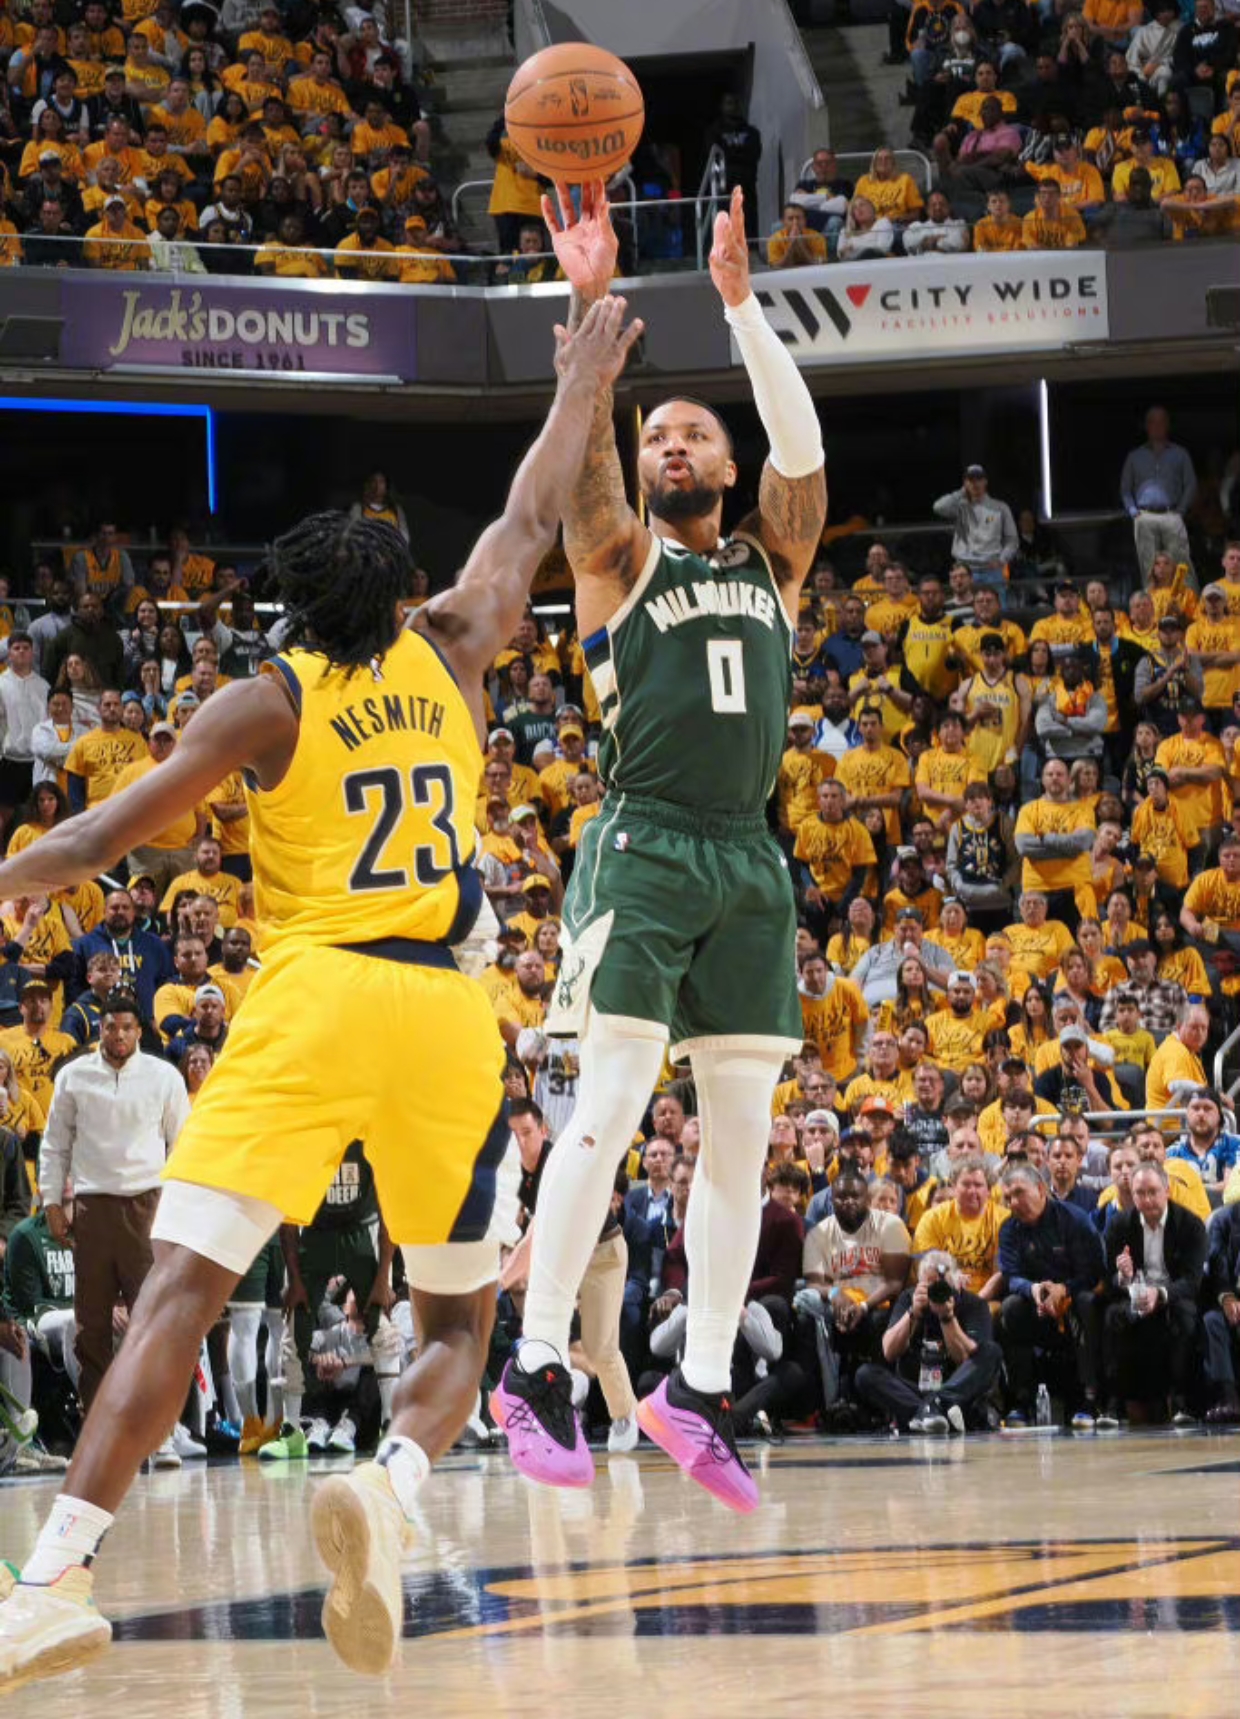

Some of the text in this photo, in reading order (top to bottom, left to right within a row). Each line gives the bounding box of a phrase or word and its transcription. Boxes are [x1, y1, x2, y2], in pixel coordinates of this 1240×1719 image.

[537, 129, 625, 160] Wilson
[880, 276, 1097, 311] CITY WIDE
[109, 289, 370, 356] Jack's DONUTS
[881, 306, 1101, 331] FACILITY SOLUTIONS
[181, 350, 306, 371] SINCE 1961
[644, 580, 776, 634] MILWUKEE
[707, 639, 747, 714] 0
[329, 694, 446, 751] NESMITH
[524, 721, 557, 740] BUCK
[343, 764, 461, 893] 23
